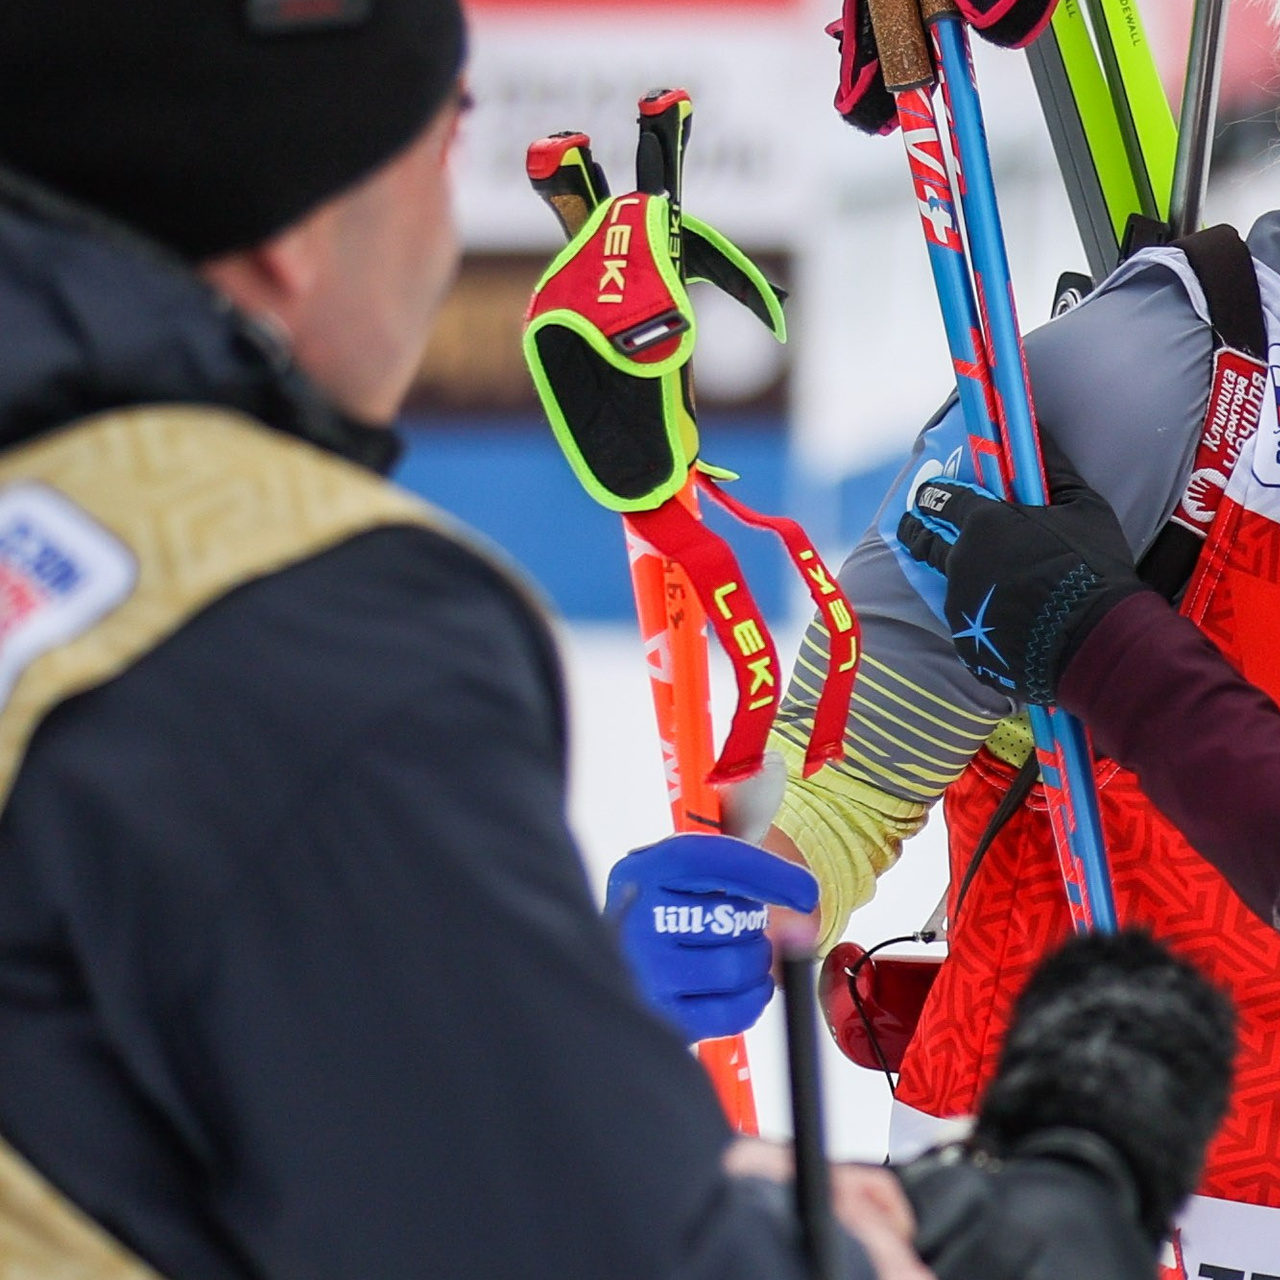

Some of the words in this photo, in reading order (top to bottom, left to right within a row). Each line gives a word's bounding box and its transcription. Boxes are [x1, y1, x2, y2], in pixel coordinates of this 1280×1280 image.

[597, 198, 640, 303] LEKI
[1202, 369, 1237, 452] Клиника
[714, 581, 774, 710] LEKI
[799, 550, 854, 673] LEKI
